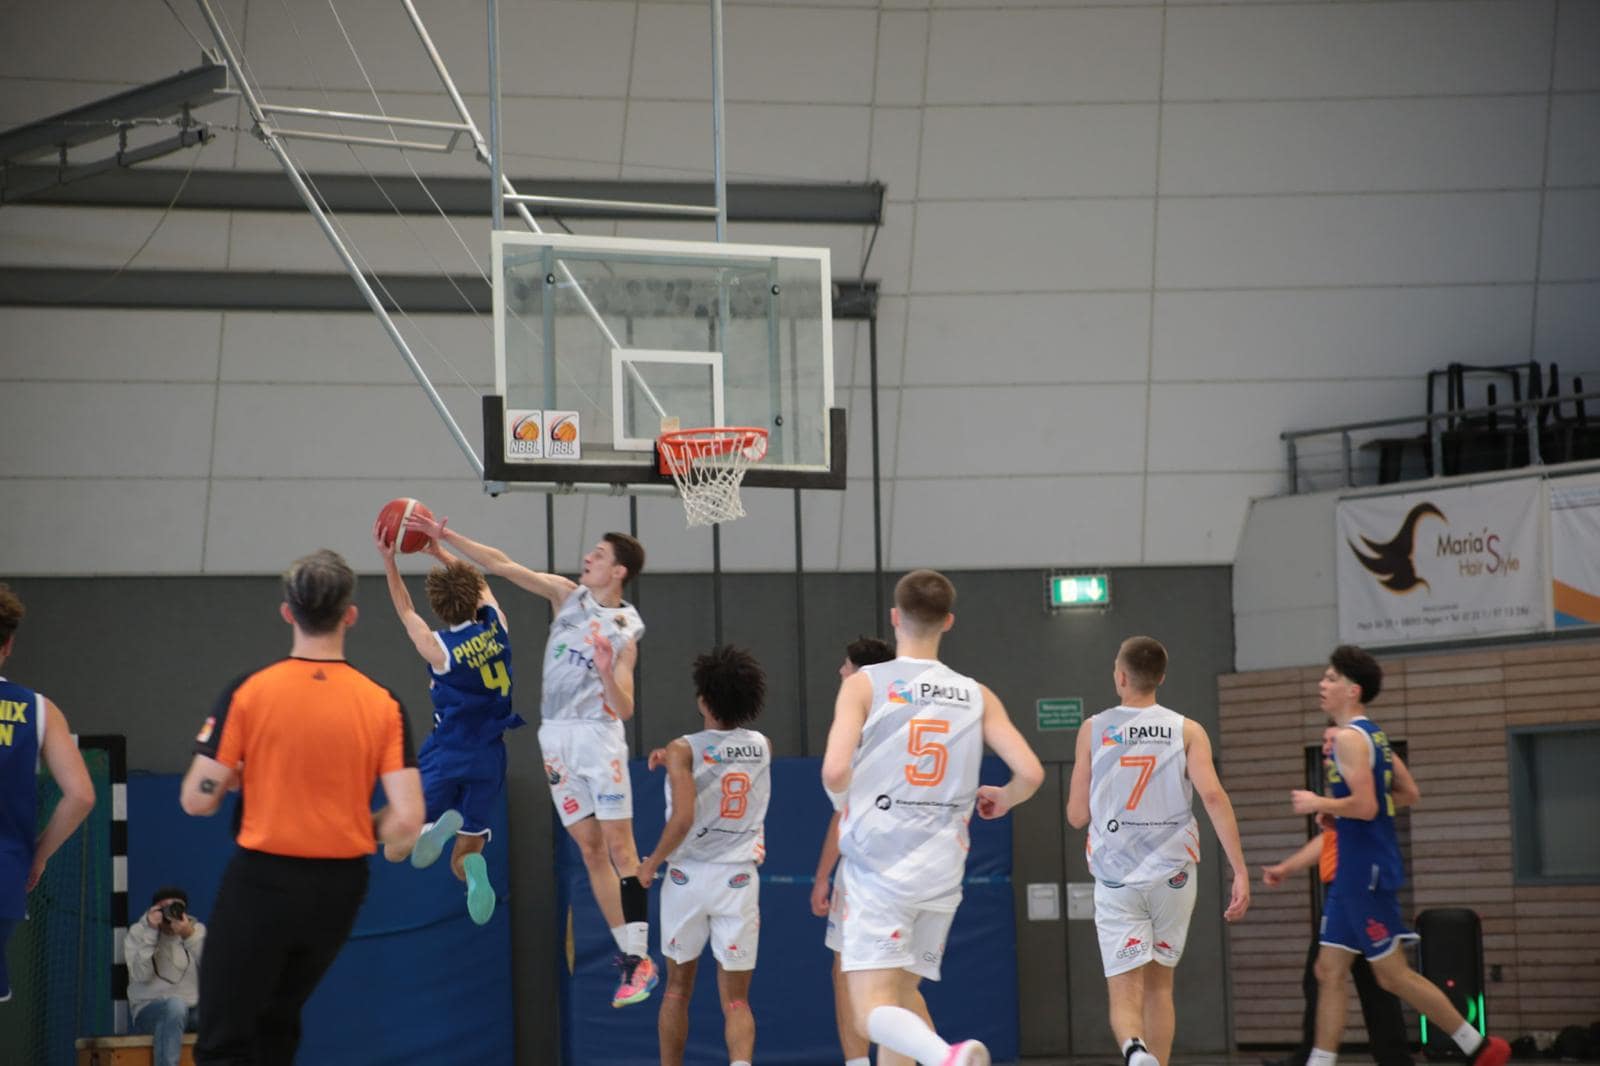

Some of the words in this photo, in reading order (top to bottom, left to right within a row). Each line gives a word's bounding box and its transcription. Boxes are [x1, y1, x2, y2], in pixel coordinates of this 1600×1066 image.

[511, 441, 539, 454] NBBL
[1458, 557, 1484, 577] Hair
[480, 660, 512, 697] 4
[920, 682, 971, 702] PAULI
[1129, 726, 1172, 739] PAULI
[726, 745, 763, 758] PAULI
[904, 718, 951, 787] 5
[1120, 755, 1157, 811] 7
[720, 772, 751, 819] 8
